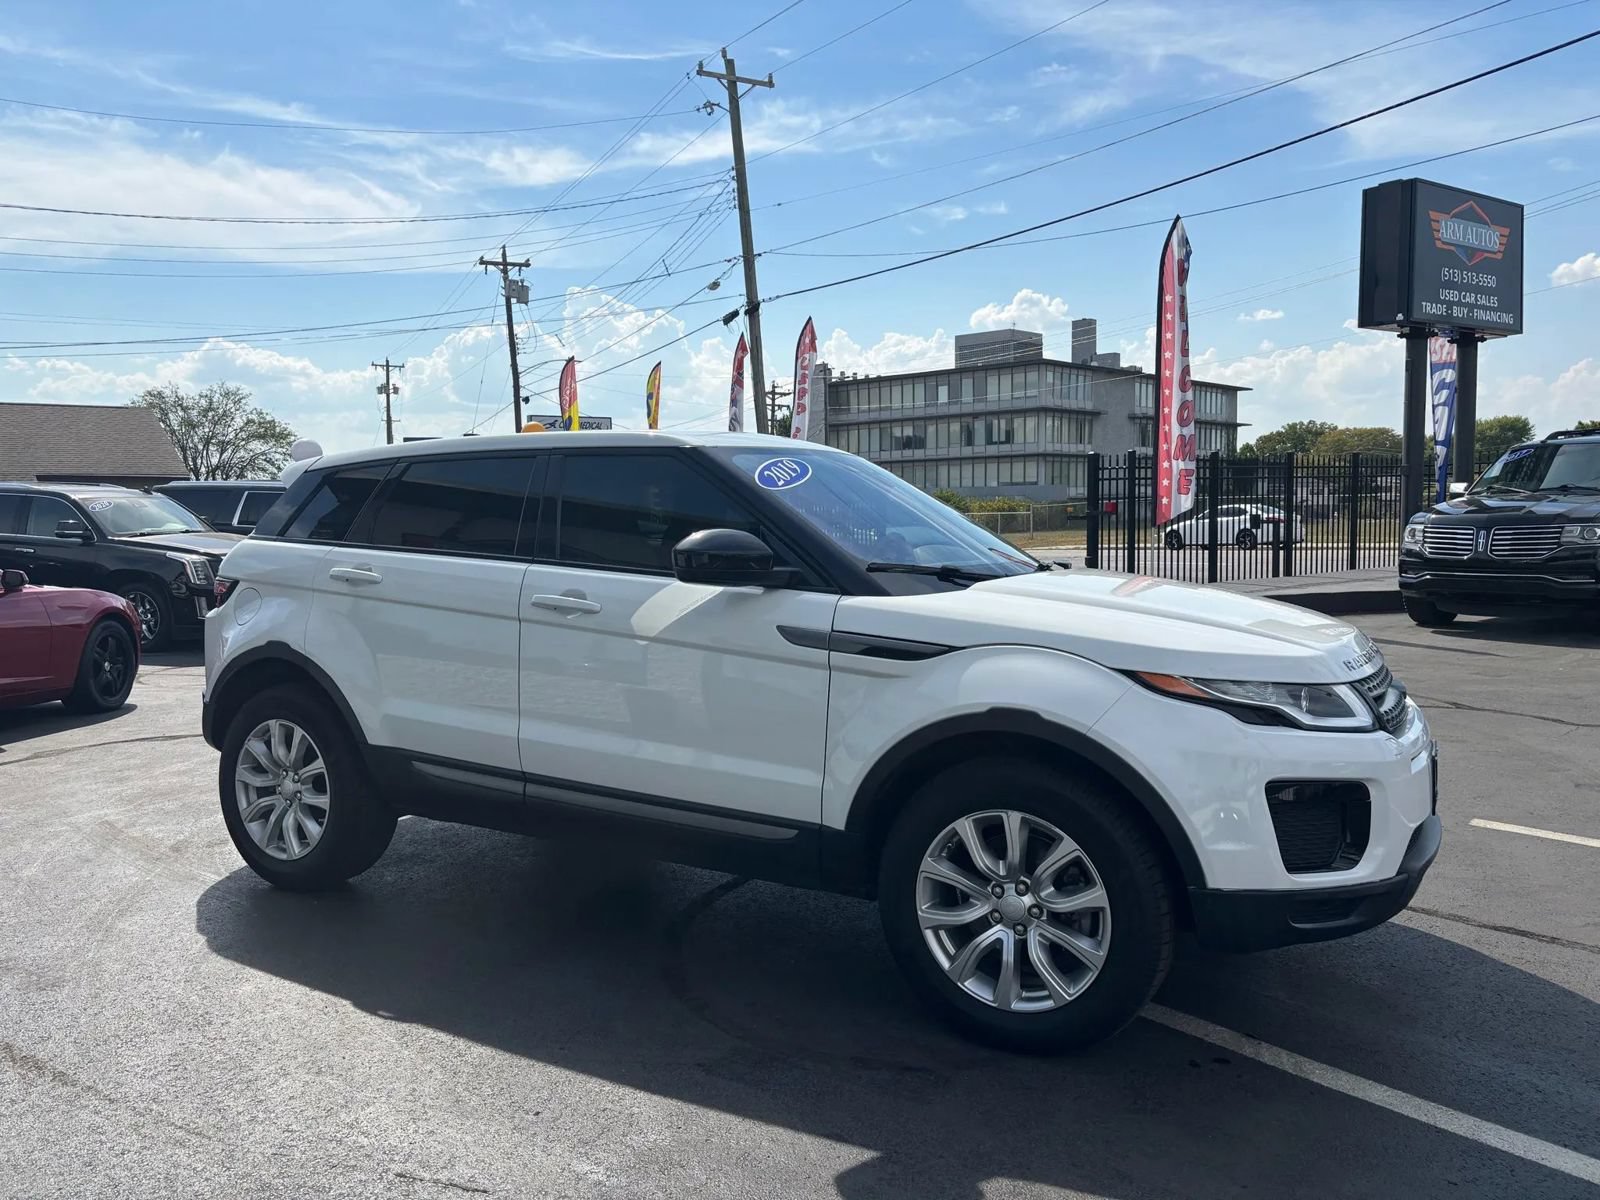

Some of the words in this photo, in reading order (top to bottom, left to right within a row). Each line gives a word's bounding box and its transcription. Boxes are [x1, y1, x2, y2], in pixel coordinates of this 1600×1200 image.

[1439, 220, 1464, 241] ARM
[1465, 226, 1500, 249] AUTOS
[1441, 267, 1461, 284] (513)
[1462, 271, 1497, 288] 513-5550
[1440, 288, 1459, 302] USED
[1460, 291, 1476, 304] CAR
[1477, 294, 1498, 307] SALES
[1421, 301, 1447, 316] TRADE
[1452, 305, 1469, 318] BUY
[1473, 308, 1514, 324] FINANCING
[764, 460, 801, 486] 2019
